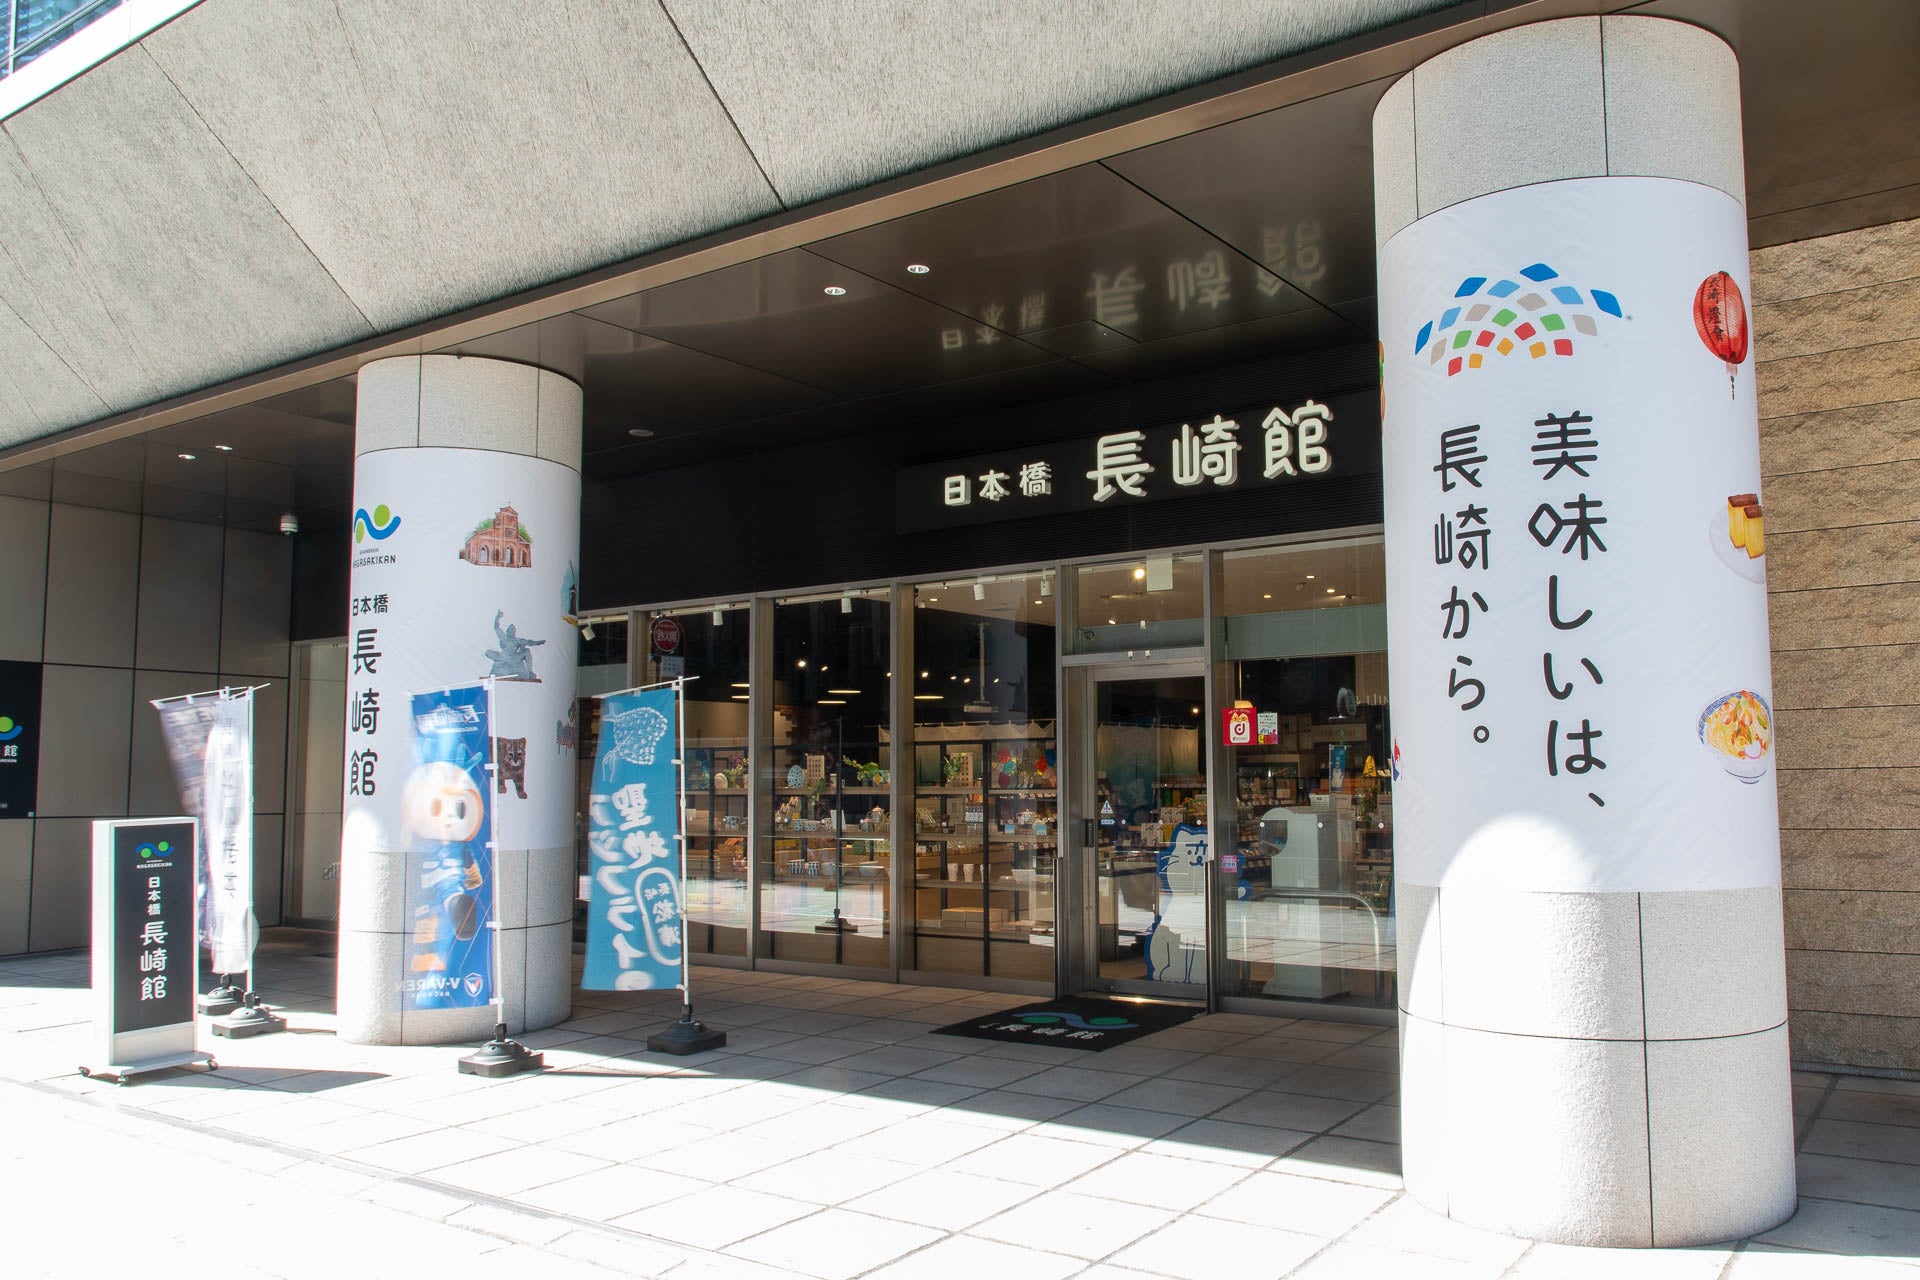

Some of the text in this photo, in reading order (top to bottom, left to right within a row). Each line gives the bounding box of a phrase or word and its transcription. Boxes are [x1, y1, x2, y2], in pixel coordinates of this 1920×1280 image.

[944, 400, 1334, 506] 日本橋 長崎館
[352, 593, 389, 617] 日本橋
[1433, 424, 1492, 744] 長崎から。
[1527, 410, 1608, 808] 美味しいは、
[349, 628, 382, 796] 長崎館
[147, 876, 161, 916] 日本橋
[139, 921, 168, 1000] 長崎館
